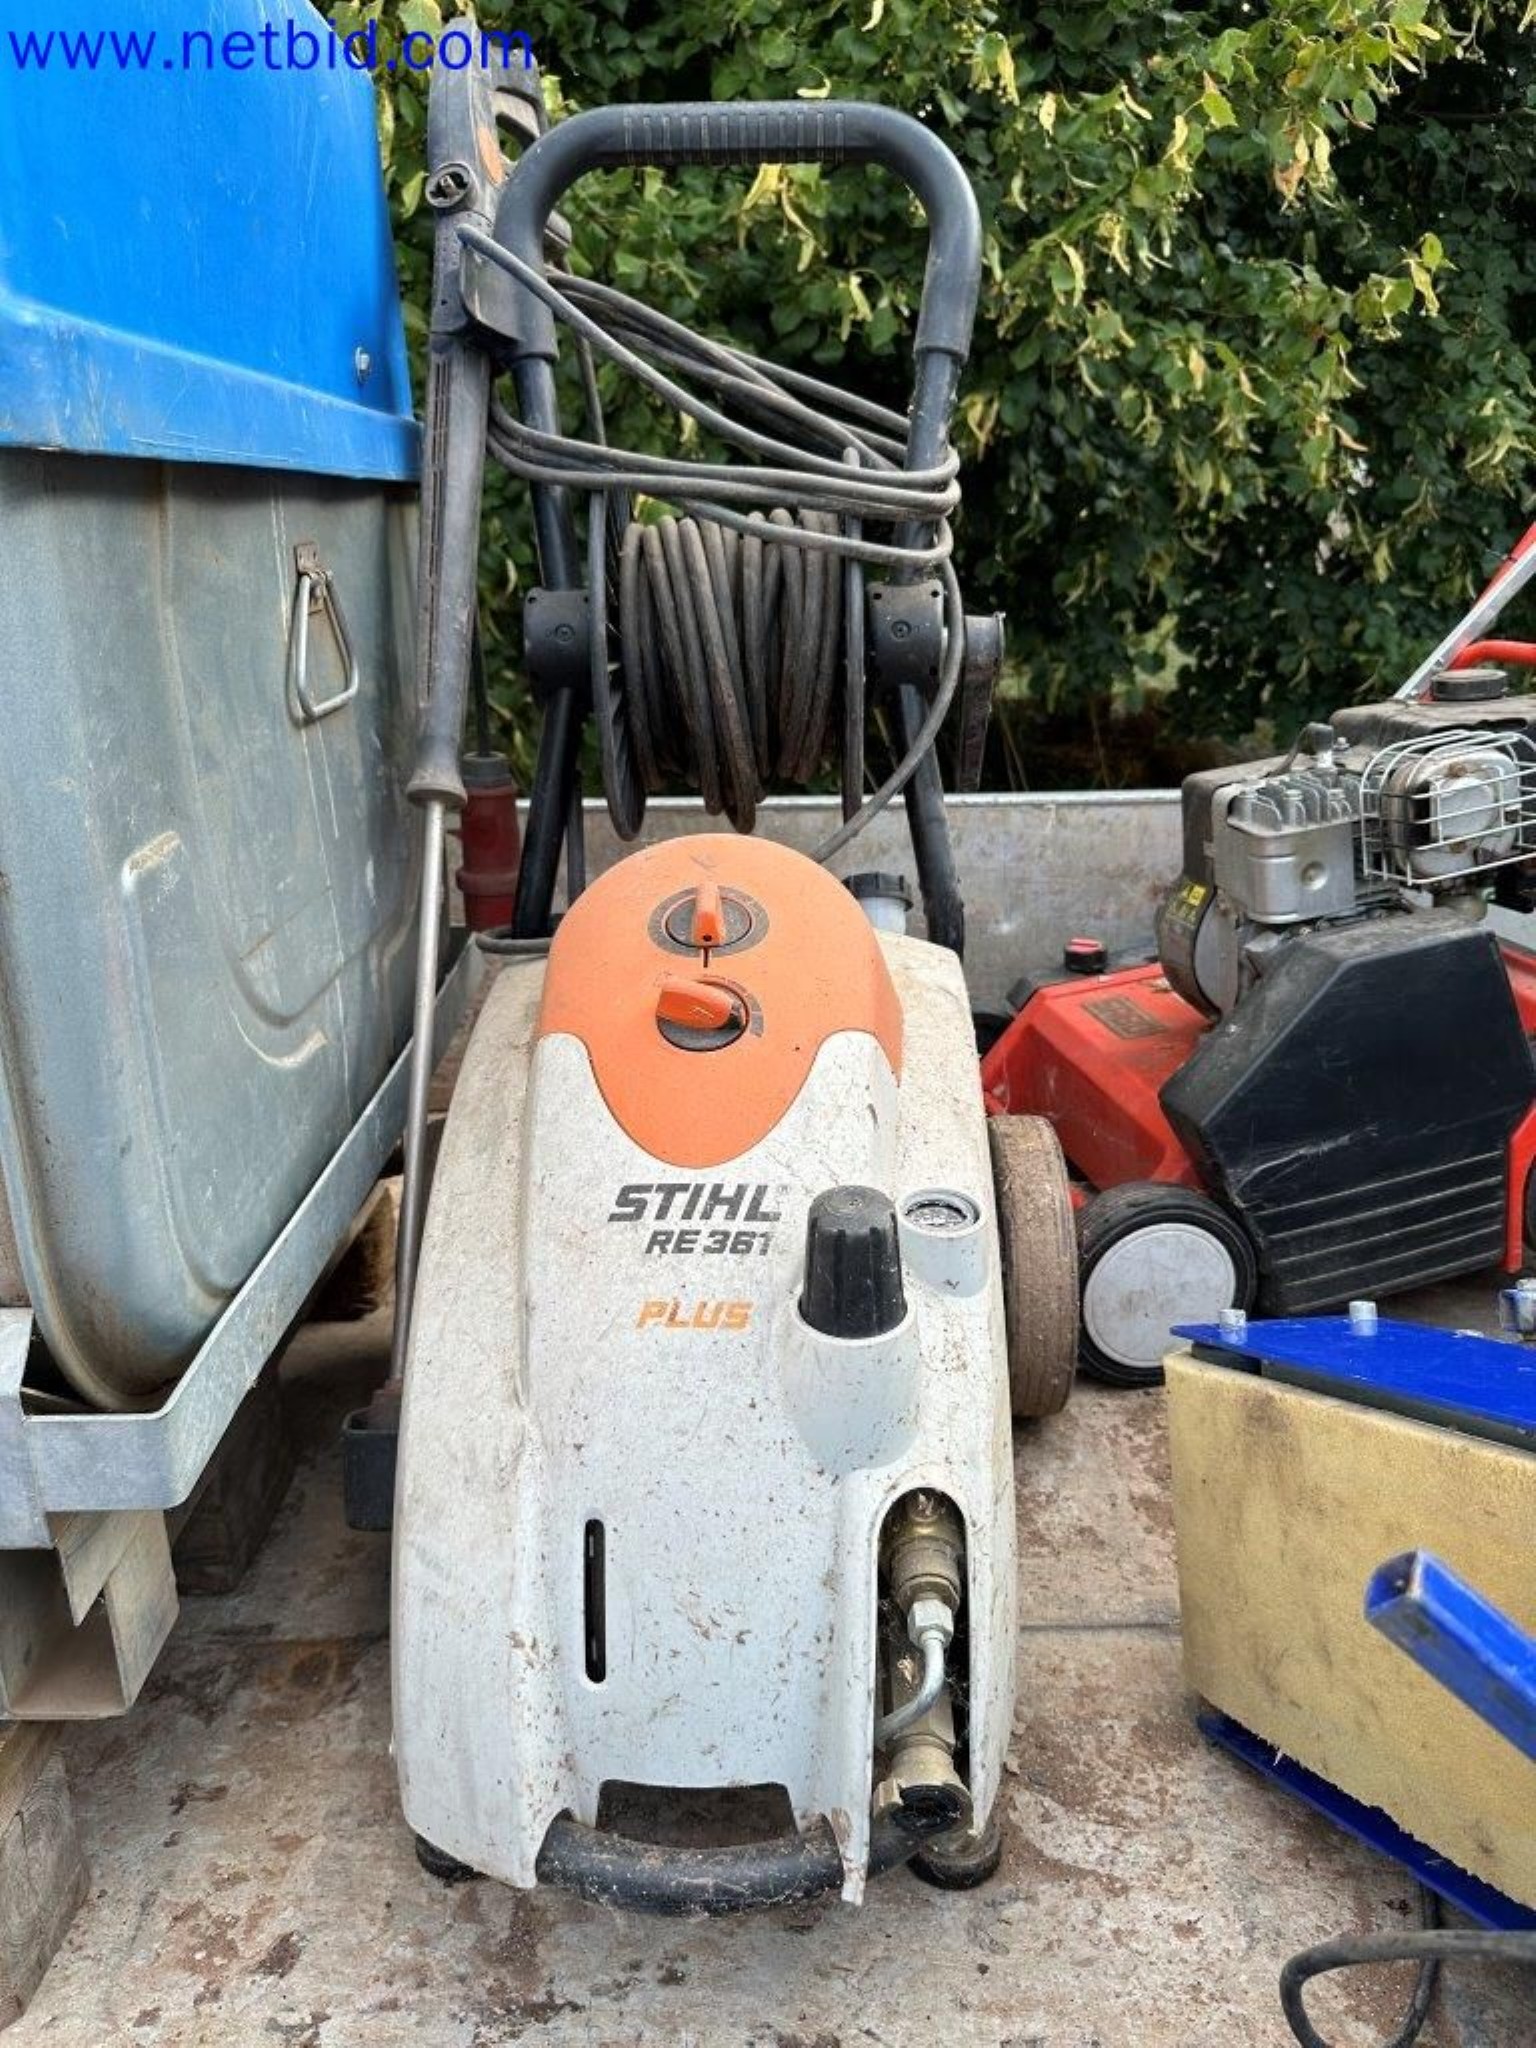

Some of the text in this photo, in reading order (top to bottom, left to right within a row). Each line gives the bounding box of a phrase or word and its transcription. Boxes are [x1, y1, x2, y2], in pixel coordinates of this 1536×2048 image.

[608, 1183, 782, 1222] STIHL
[645, 1229, 774, 1256] RE 361
[635, 1298, 753, 1329] PLUS
